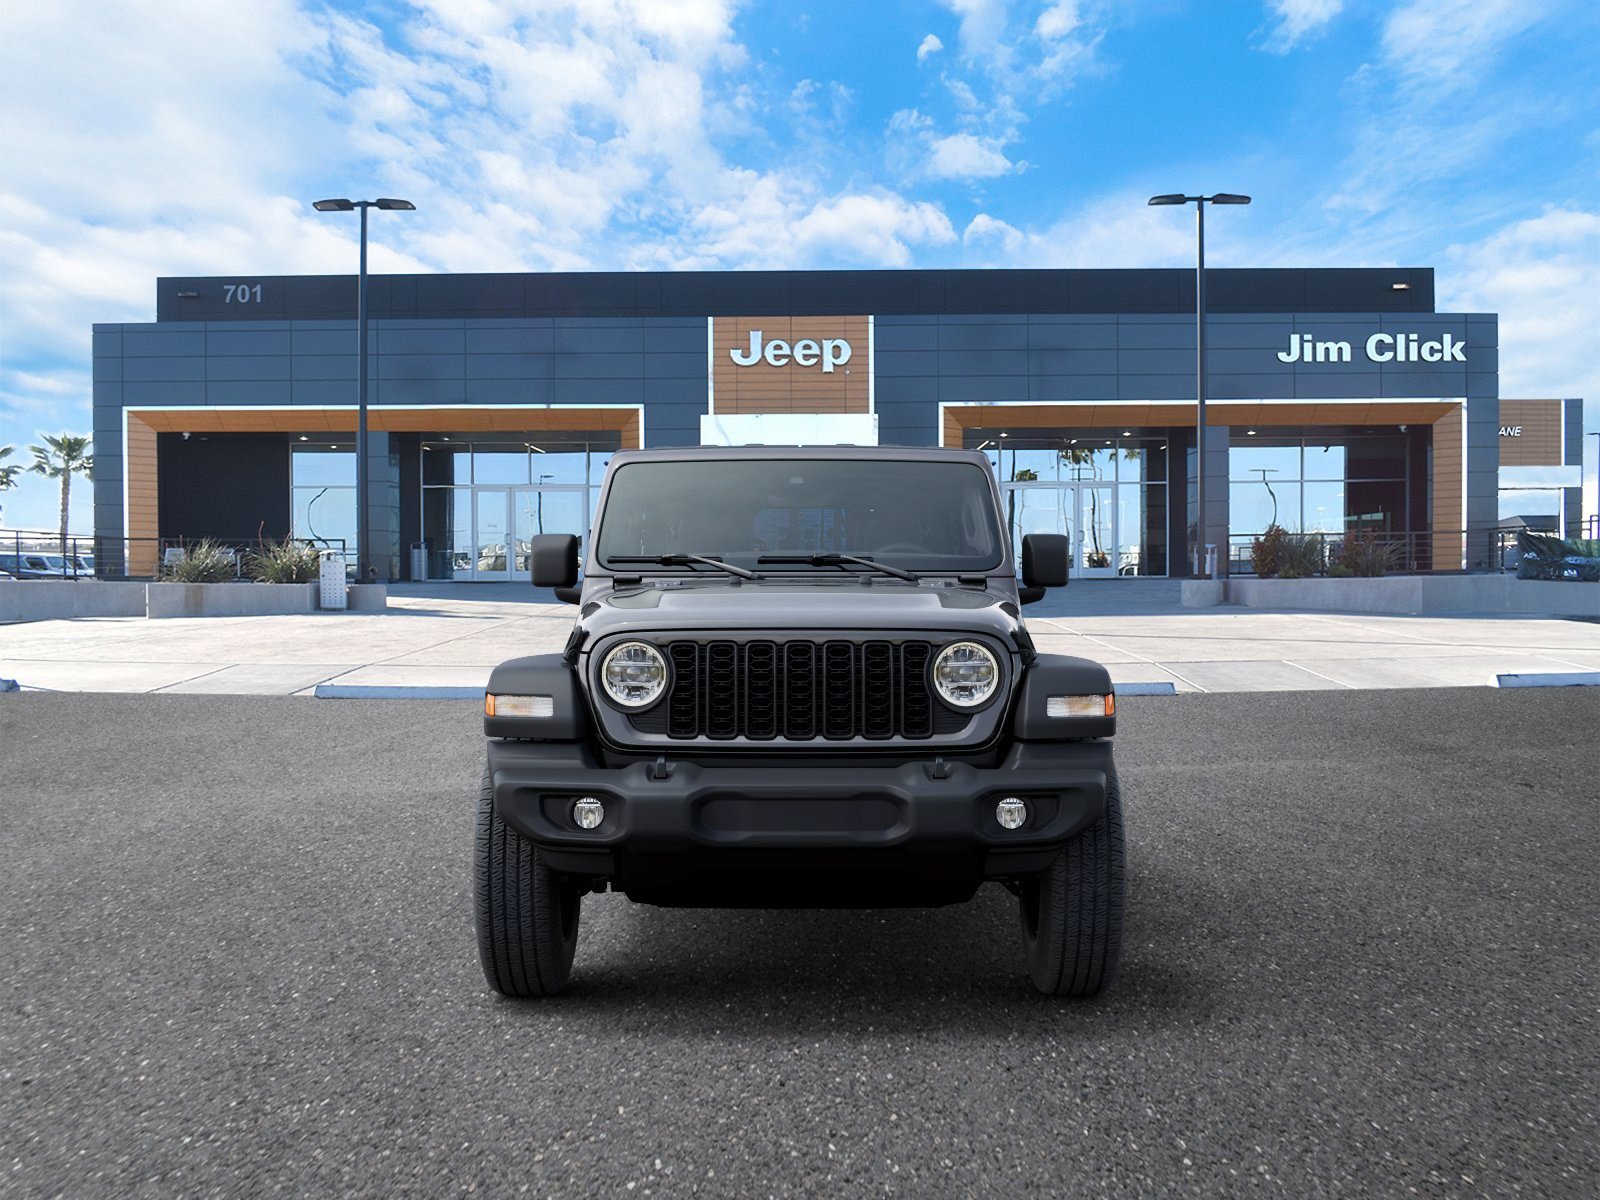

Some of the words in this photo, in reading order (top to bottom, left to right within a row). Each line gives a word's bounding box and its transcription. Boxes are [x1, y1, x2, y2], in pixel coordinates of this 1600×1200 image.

[223, 284, 261, 304] 701
[729, 330, 852, 373] Jeep
[1277, 333, 1351, 363] Jim
[1366, 333, 1467, 363] Click
